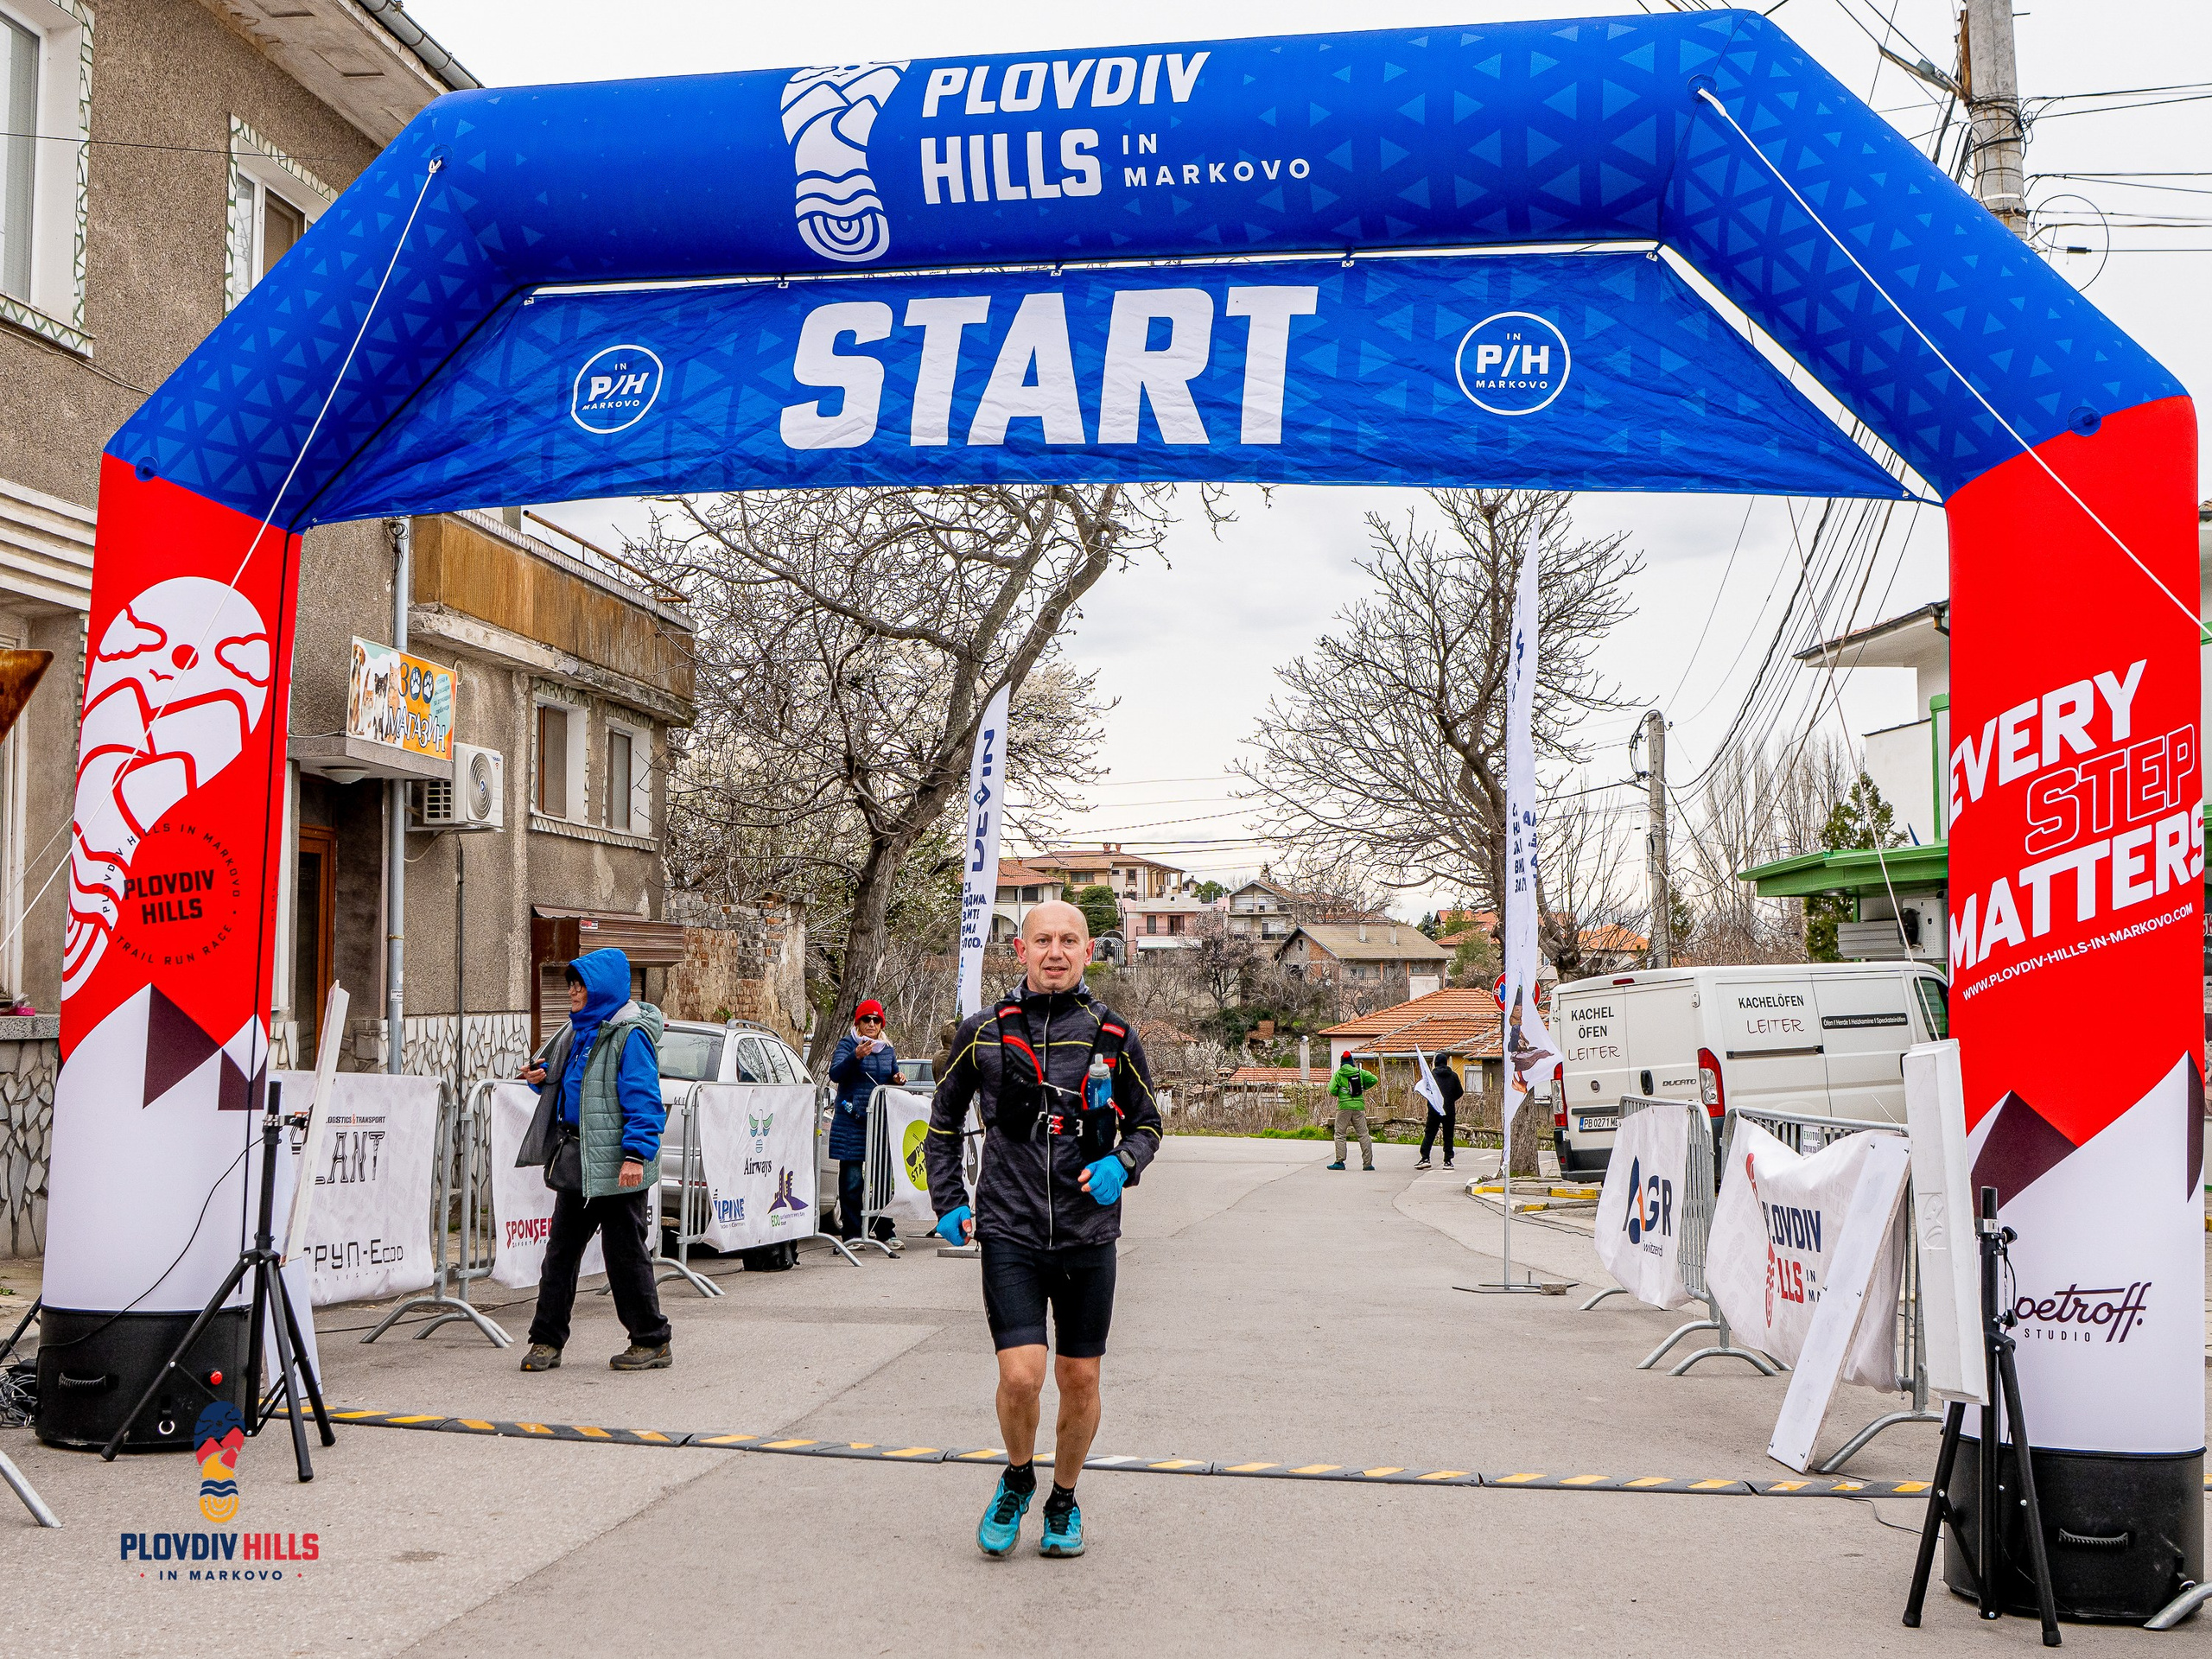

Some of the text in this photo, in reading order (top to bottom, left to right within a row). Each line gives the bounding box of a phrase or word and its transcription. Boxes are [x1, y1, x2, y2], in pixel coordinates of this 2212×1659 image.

[922, 51, 1211, 118] PLOVDIV
[1123, 133, 1156, 156] IN
[921, 128, 1103, 205] HILLS
[1124, 158, 1311, 188] MARKOVO
[779, 285, 1318, 449] START
[1476, 344, 1549, 378] P/H
[588, 372, 649, 402] P/H
[1476, 380, 1548, 389] MARKOVO
[582, 400, 640, 410] MARKOVO
[388, 706, 446, 753] МАГАЗИН
[1949, 658, 2148, 830] EVERY
[2025, 723, 2195, 855] STEP
[102, 848, 124, 913] PLOVDIV
[127, 823, 170, 845] HILLS
[181, 823, 196, 836] IN
[203, 833, 240, 897] MARKOVO
[124, 869, 214, 900] PLOVDIV
[1949, 799, 2204, 988] MATTERS
[142, 898, 203, 925] HILLS
[116, 925, 232, 965] TRAIL RUN RACE
[1962, 902, 2194, 1001] WWW.PLOVDIV-HILLS-IN-MARKOVO.COM
[1571, 1006, 1614, 1021] KACHEL
[1738, 993, 1805, 1009] KACHELÖFEN
[1578, 1024, 1607, 1039] ÖFEN
[1746, 1018, 1805, 1034] LEITER
[1568, 1046, 1621, 1061] LEITER
[1662, 1078, 1697, 1087] DUCATO
[1584, 1118, 1592, 1128] PB
[1593, 1117, 1610, 1128] 0271
[744, 1157, 772, 1177] Airways
[2024, 1328, 2091, 1342] STUDIO
